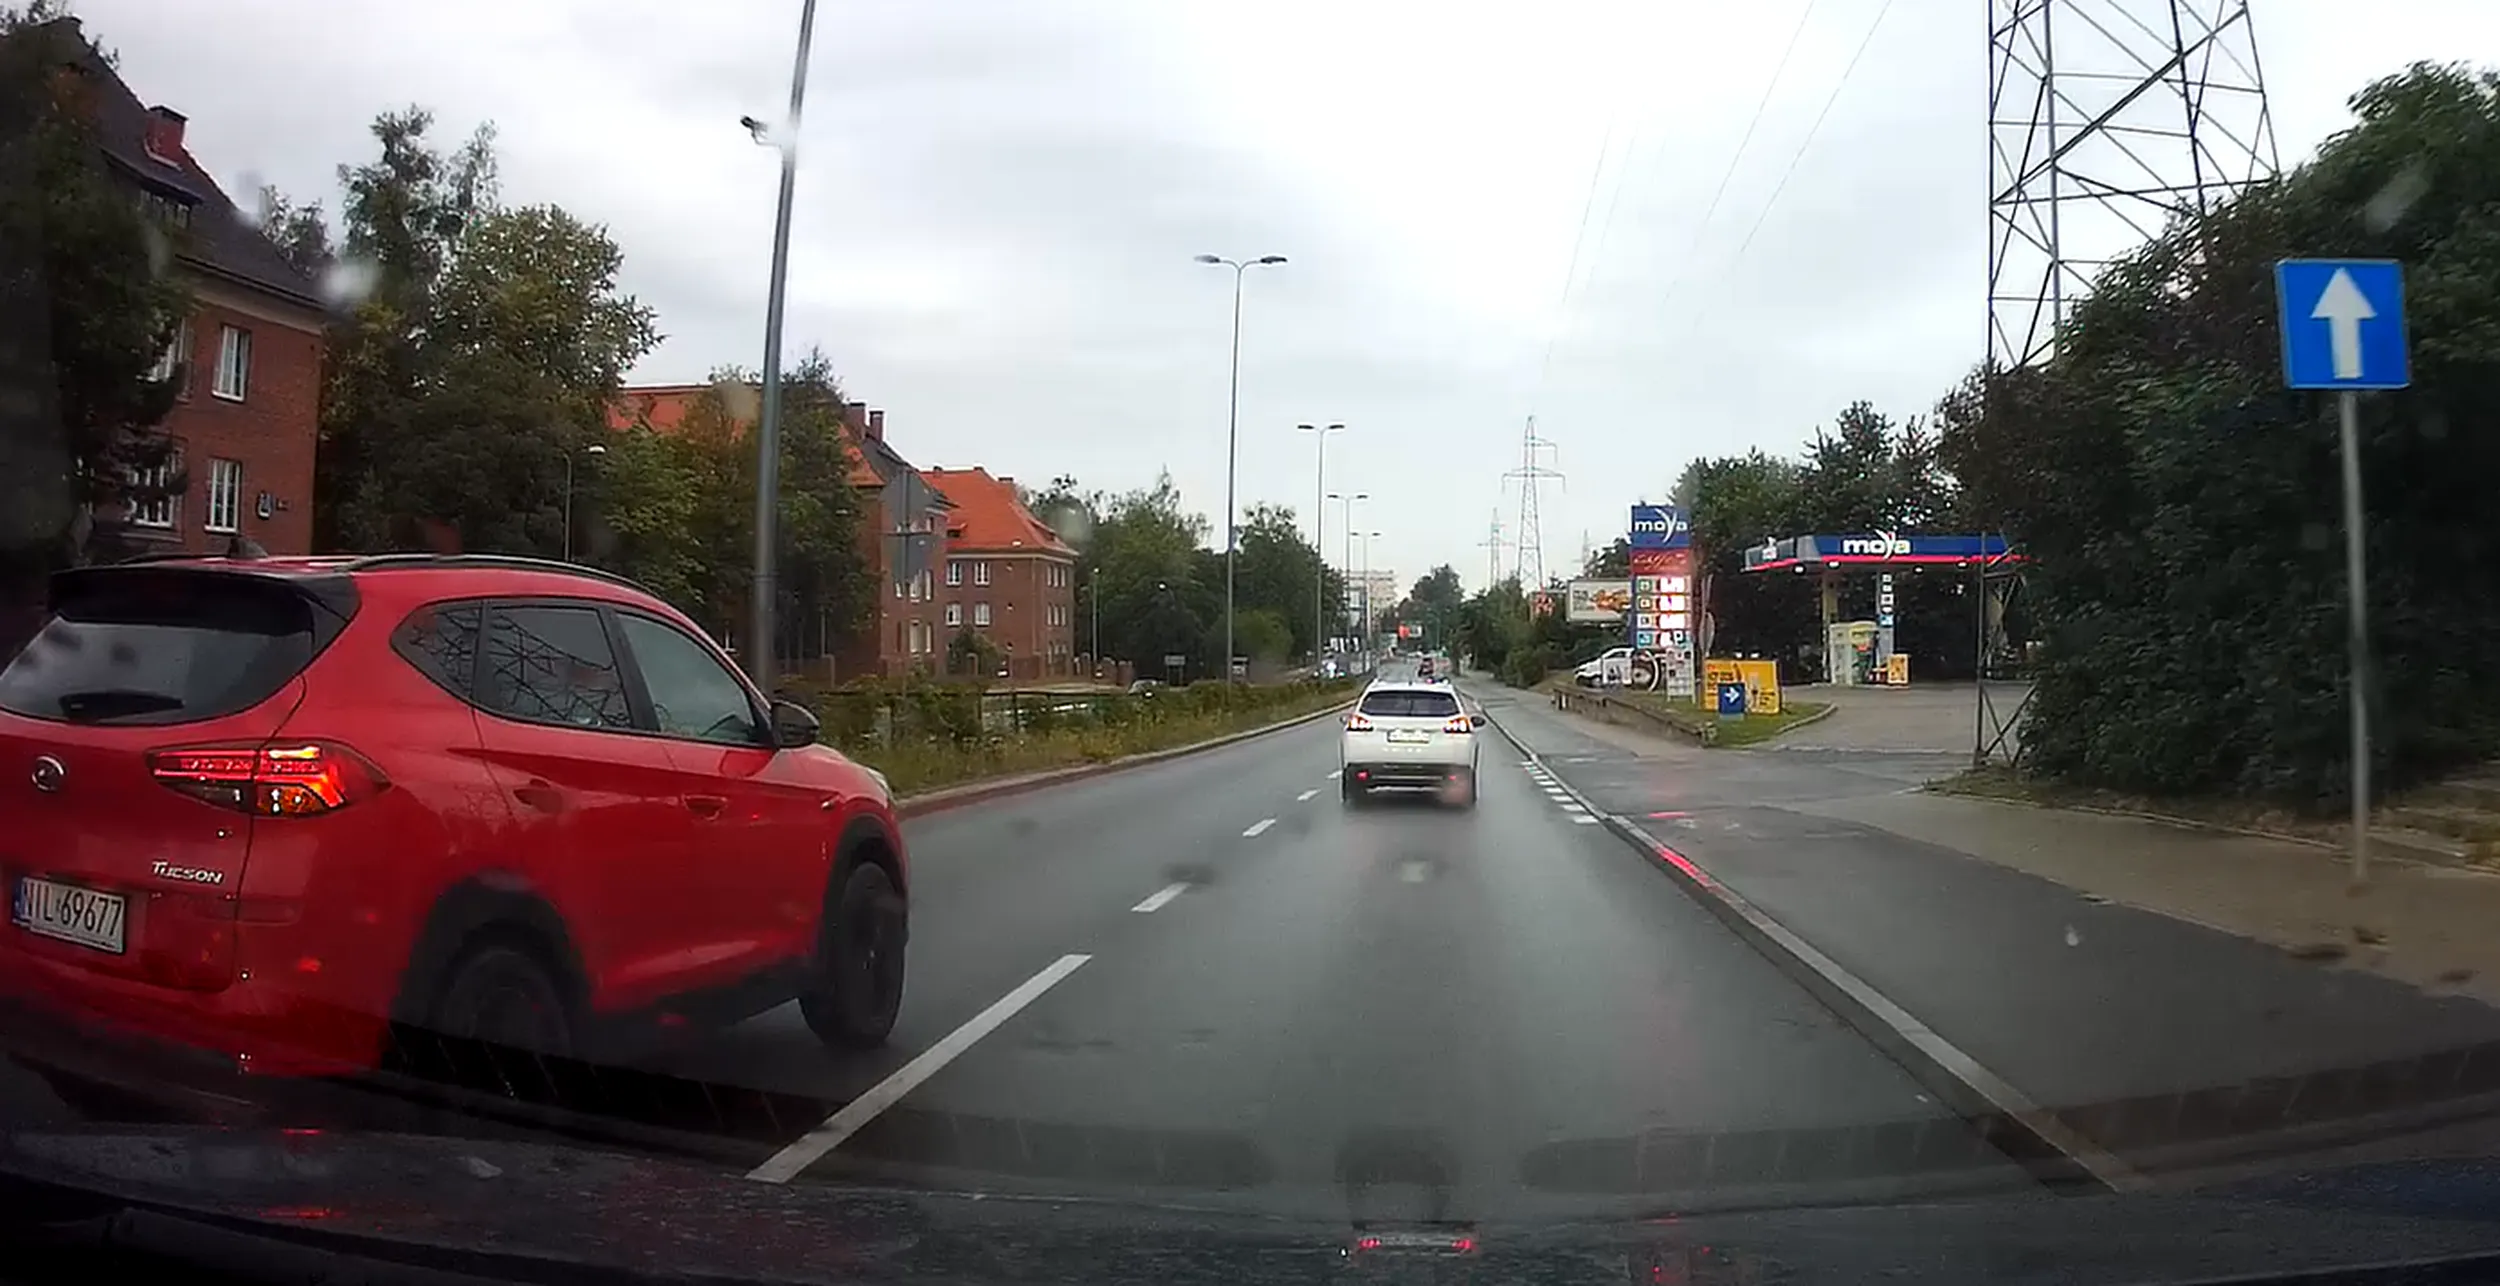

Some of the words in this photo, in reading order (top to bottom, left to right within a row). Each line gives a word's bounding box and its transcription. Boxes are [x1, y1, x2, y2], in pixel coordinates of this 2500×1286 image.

[1635, 508, 1688, 543] moya
[1843, 529, 1911, 560] moya
[152, 861, 223, 884] TUCSON
[21, 881, 53, 922] NIL
[60, 889, 122, 937] 69677
